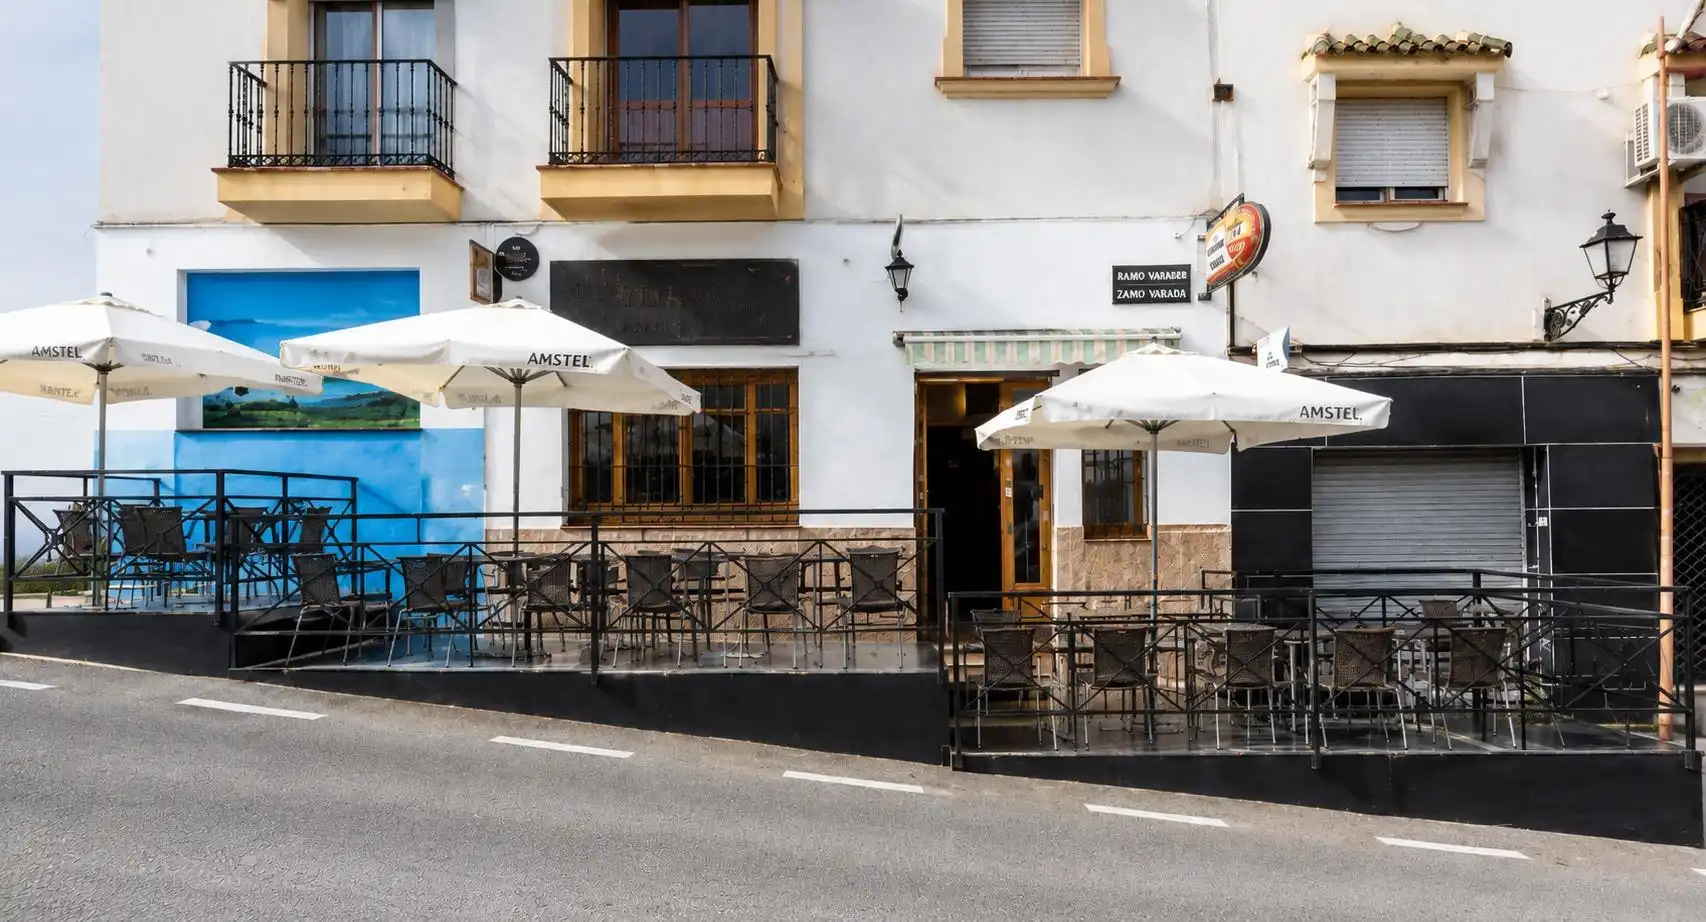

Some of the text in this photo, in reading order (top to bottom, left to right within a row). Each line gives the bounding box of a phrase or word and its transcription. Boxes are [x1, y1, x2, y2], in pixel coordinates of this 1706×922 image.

[1117, 271, 1145, 281] RAMO
[1149, 288, 1187, 298] VARADA
[31, 345, 82, 358] AMSTEL
[527, 352, 590, 368] AMSTEL
[1300, 405, 1359, 420] AMSTEL
